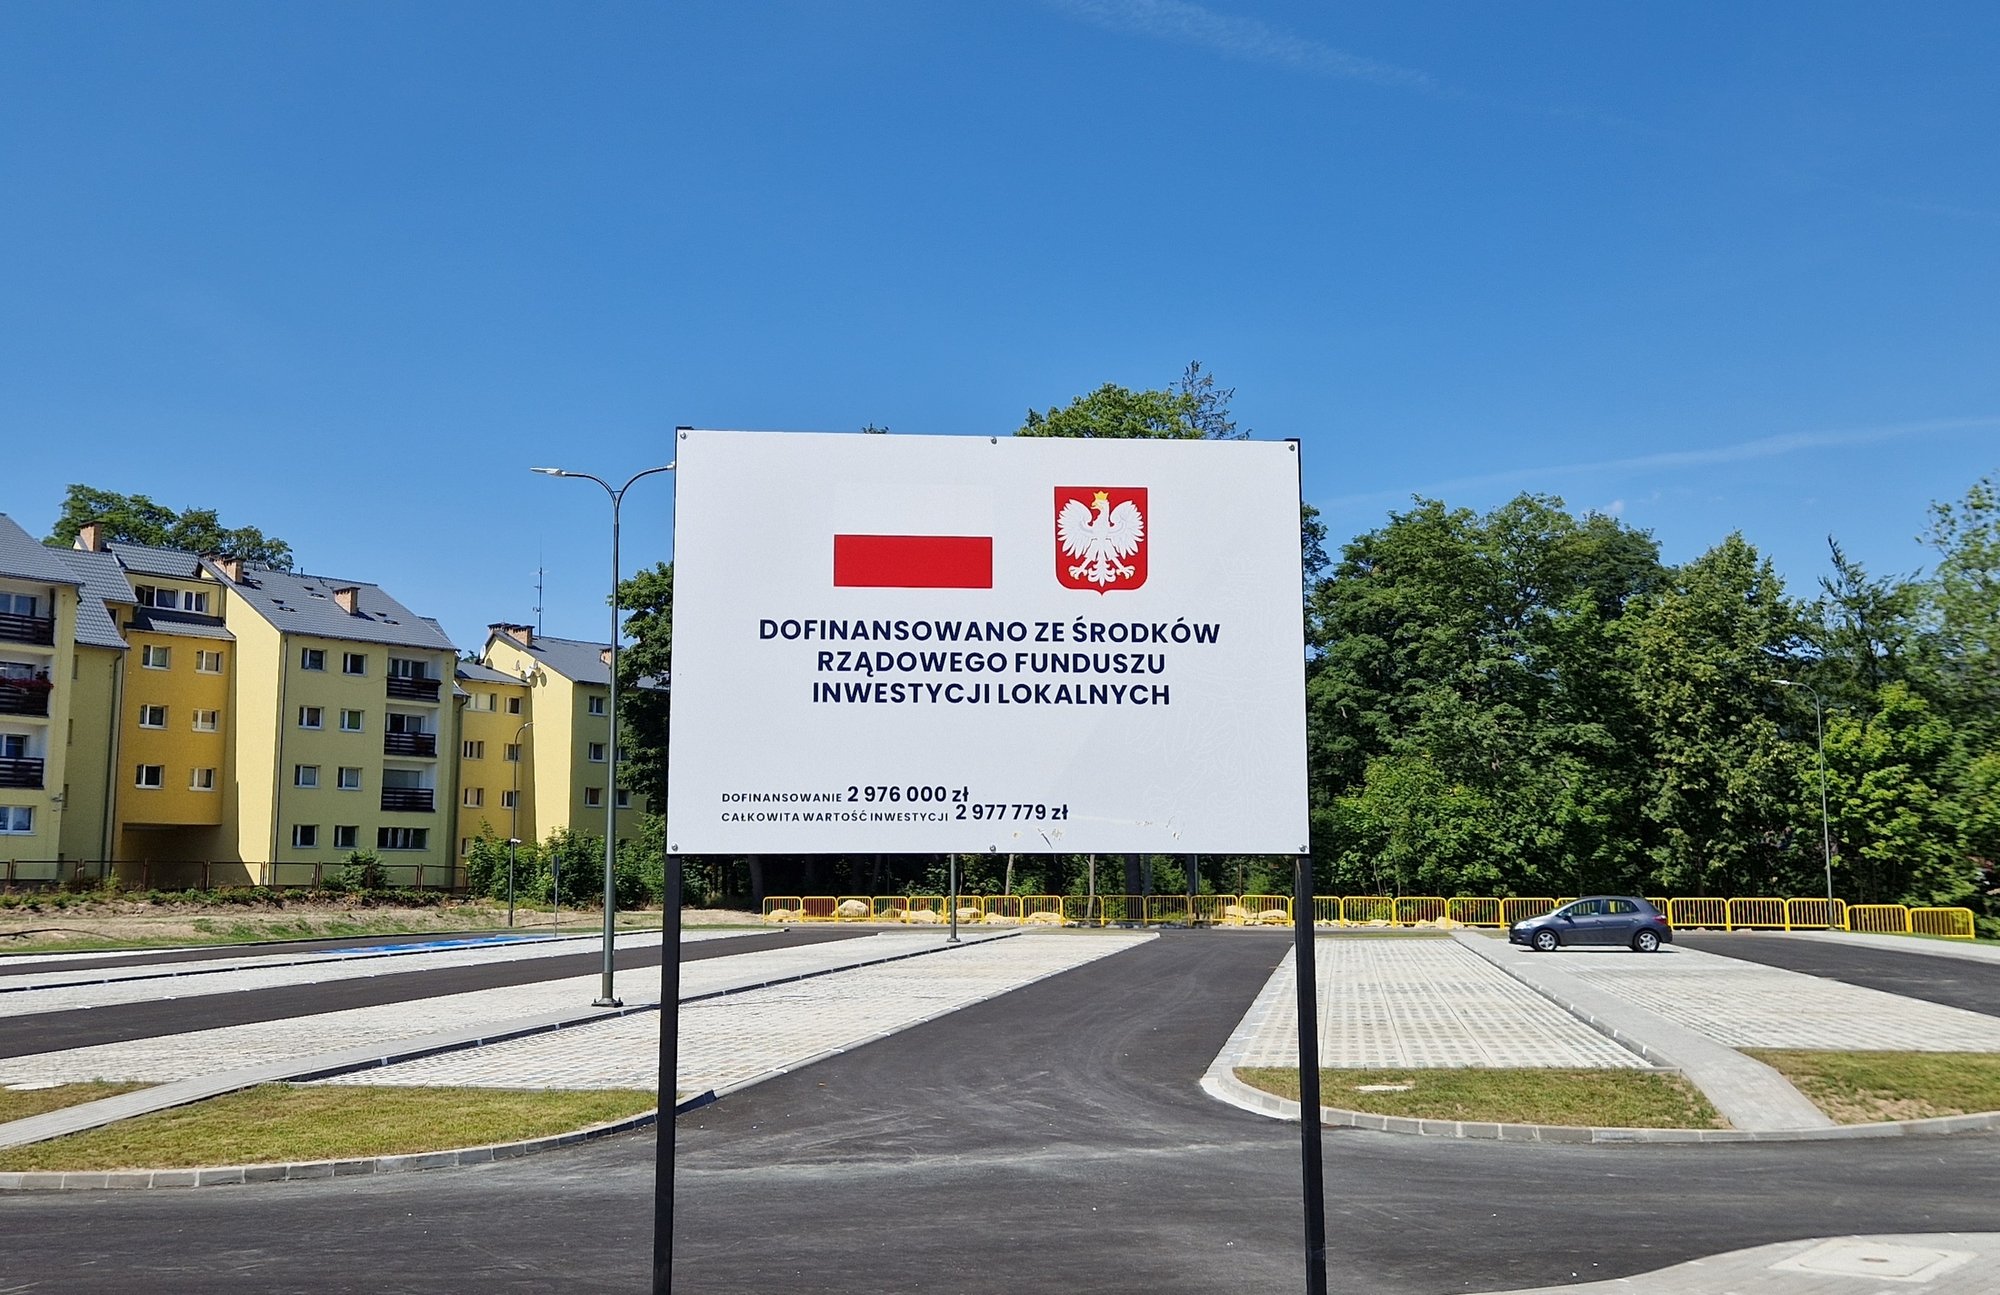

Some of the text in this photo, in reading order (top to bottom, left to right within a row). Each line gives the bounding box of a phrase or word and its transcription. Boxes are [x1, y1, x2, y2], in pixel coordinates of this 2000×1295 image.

[759, 615, 1221, 644] DOFINANSOWANO ZE ŚRODKÓW
[817, 650, 1165, 678] RZĄDOWEGO FUNDUSZU
[813, 682, 1170, 706] INWESTYCJI LOKALNYCH
[721, 785, 970, 803] DOFINANSOWANIE 2 976 000 zł
[721, 803, 1069, 822] CAŁKOWITA WARTOŚĆ INWESTYCJI 2 977 779 zł
